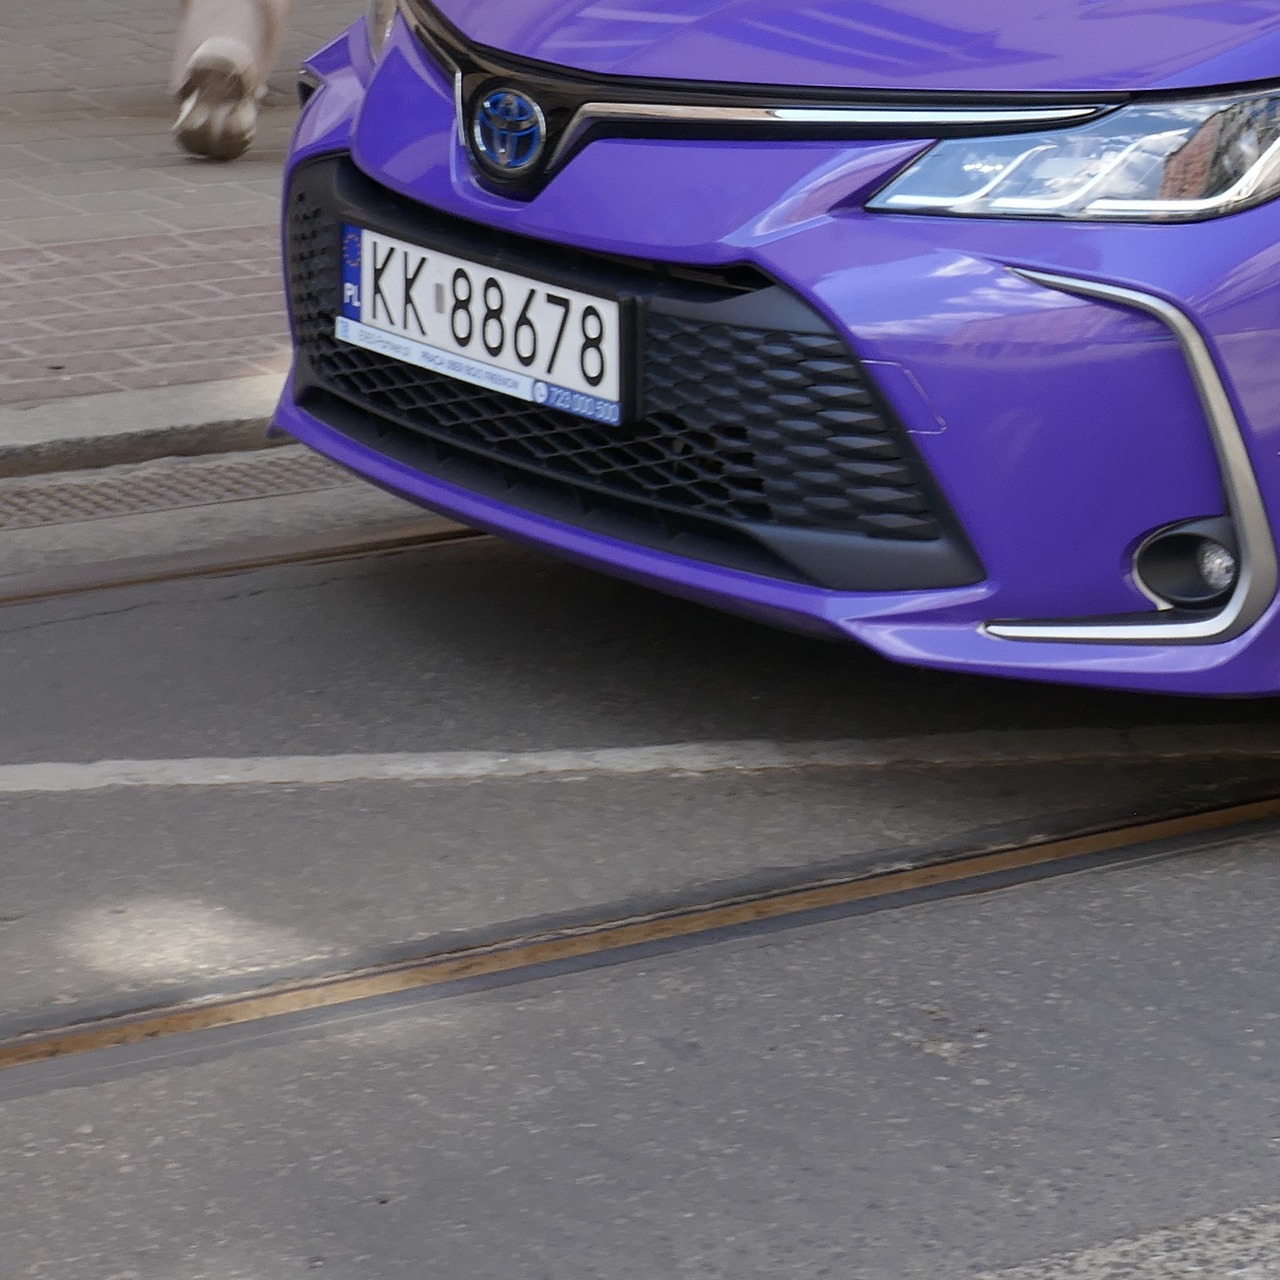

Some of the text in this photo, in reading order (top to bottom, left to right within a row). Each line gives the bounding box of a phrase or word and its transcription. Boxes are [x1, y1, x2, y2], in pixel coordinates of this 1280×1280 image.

[343, 282, 360, 307] PL
[372, 240, 605, 388] KK 88678
